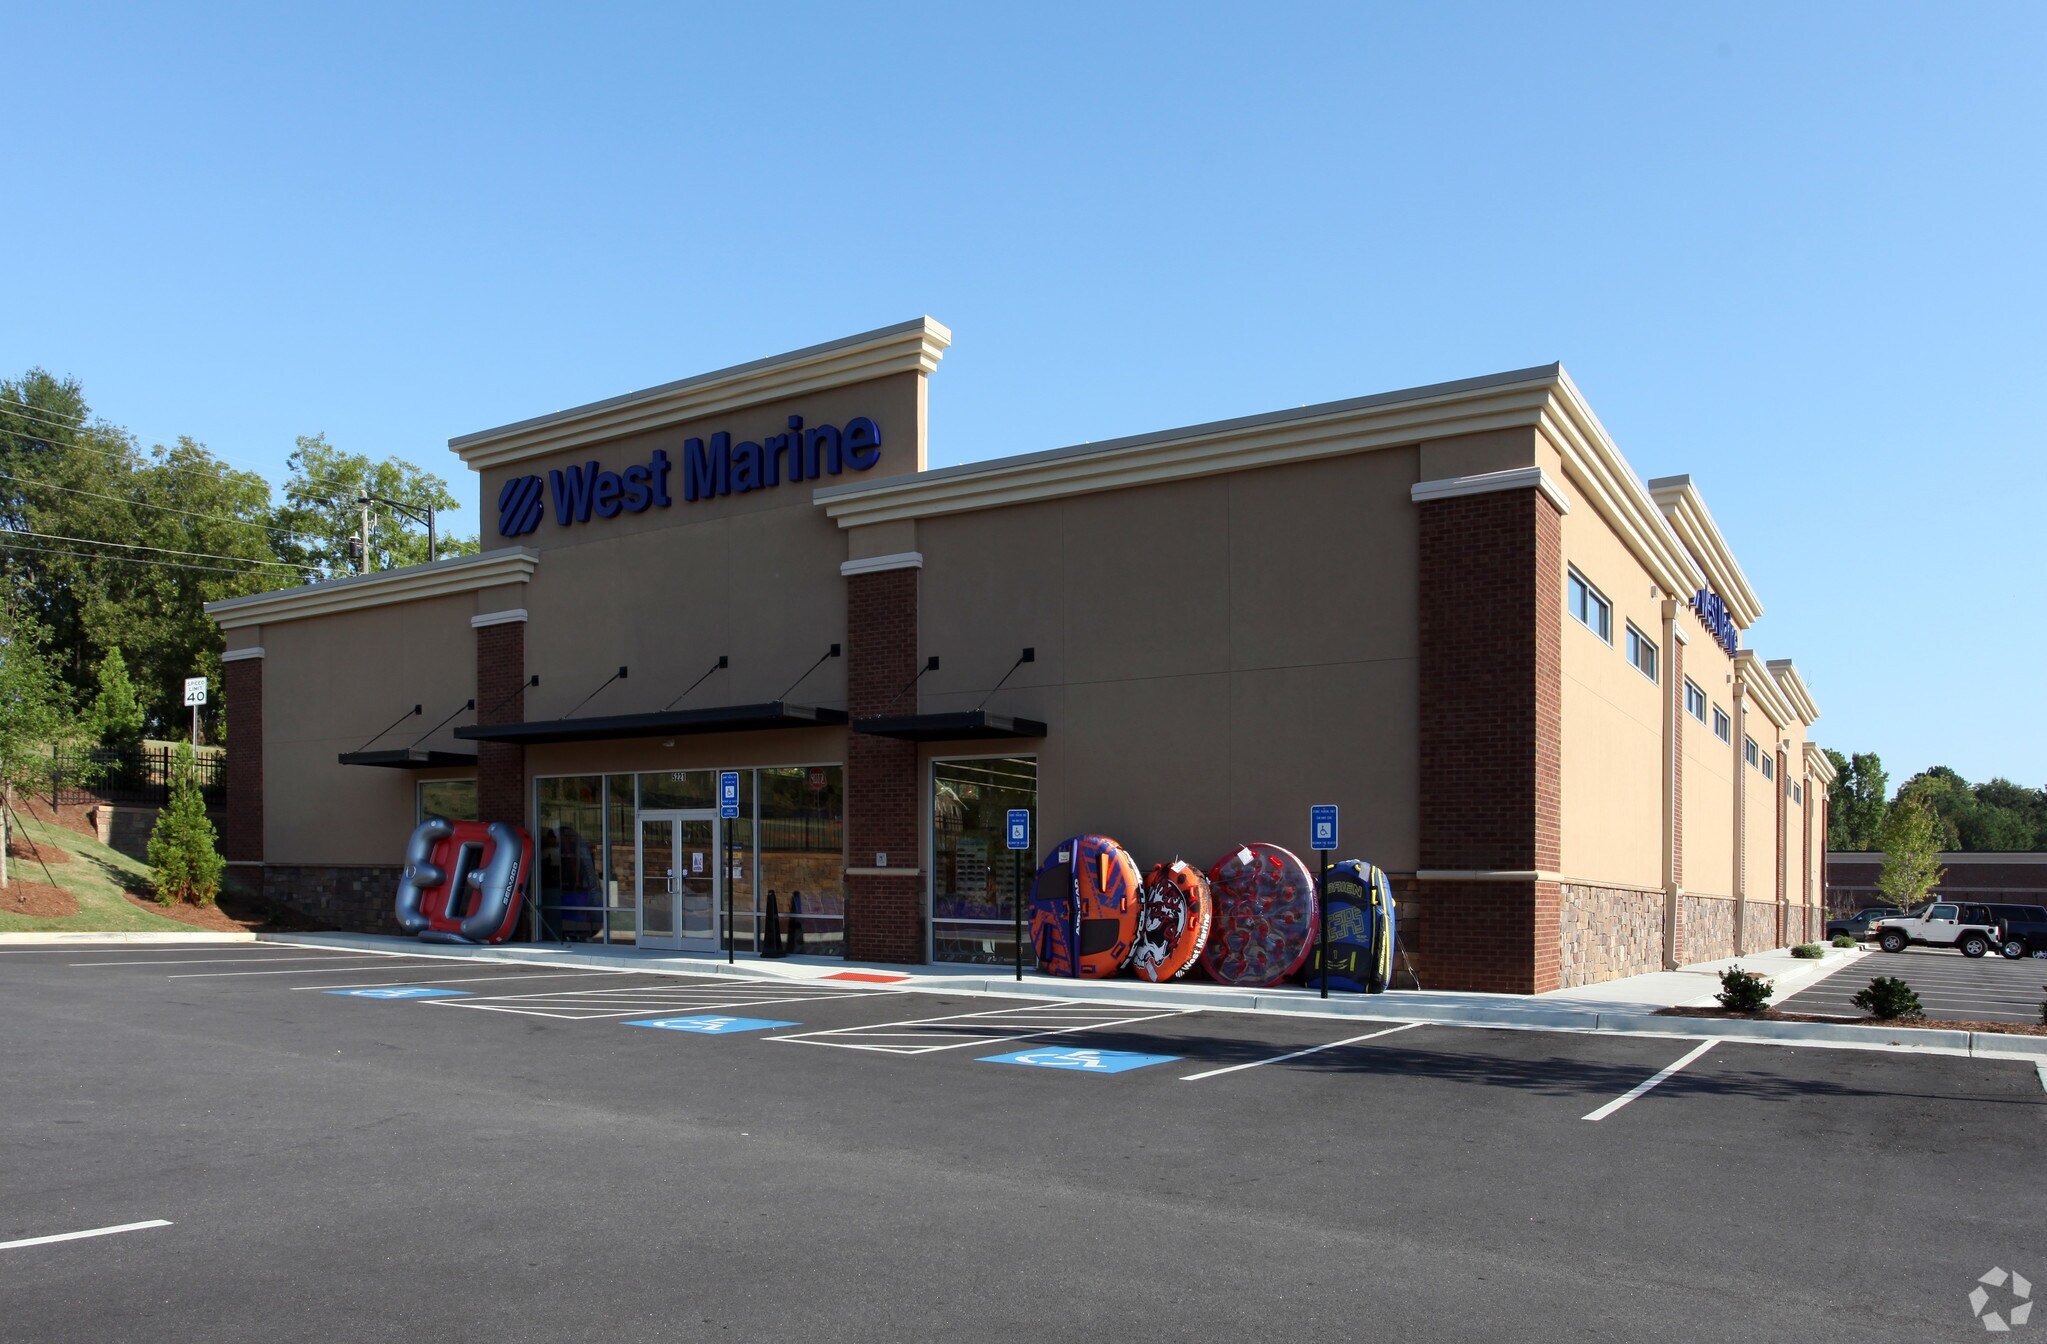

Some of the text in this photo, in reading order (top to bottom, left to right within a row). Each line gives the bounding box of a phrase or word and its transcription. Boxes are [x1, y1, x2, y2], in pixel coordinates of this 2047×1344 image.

[549, 415, 881, 526] West Marine
[187, 691, 205, 701] 40
[1181, 913, 1210, 971] West Marine
